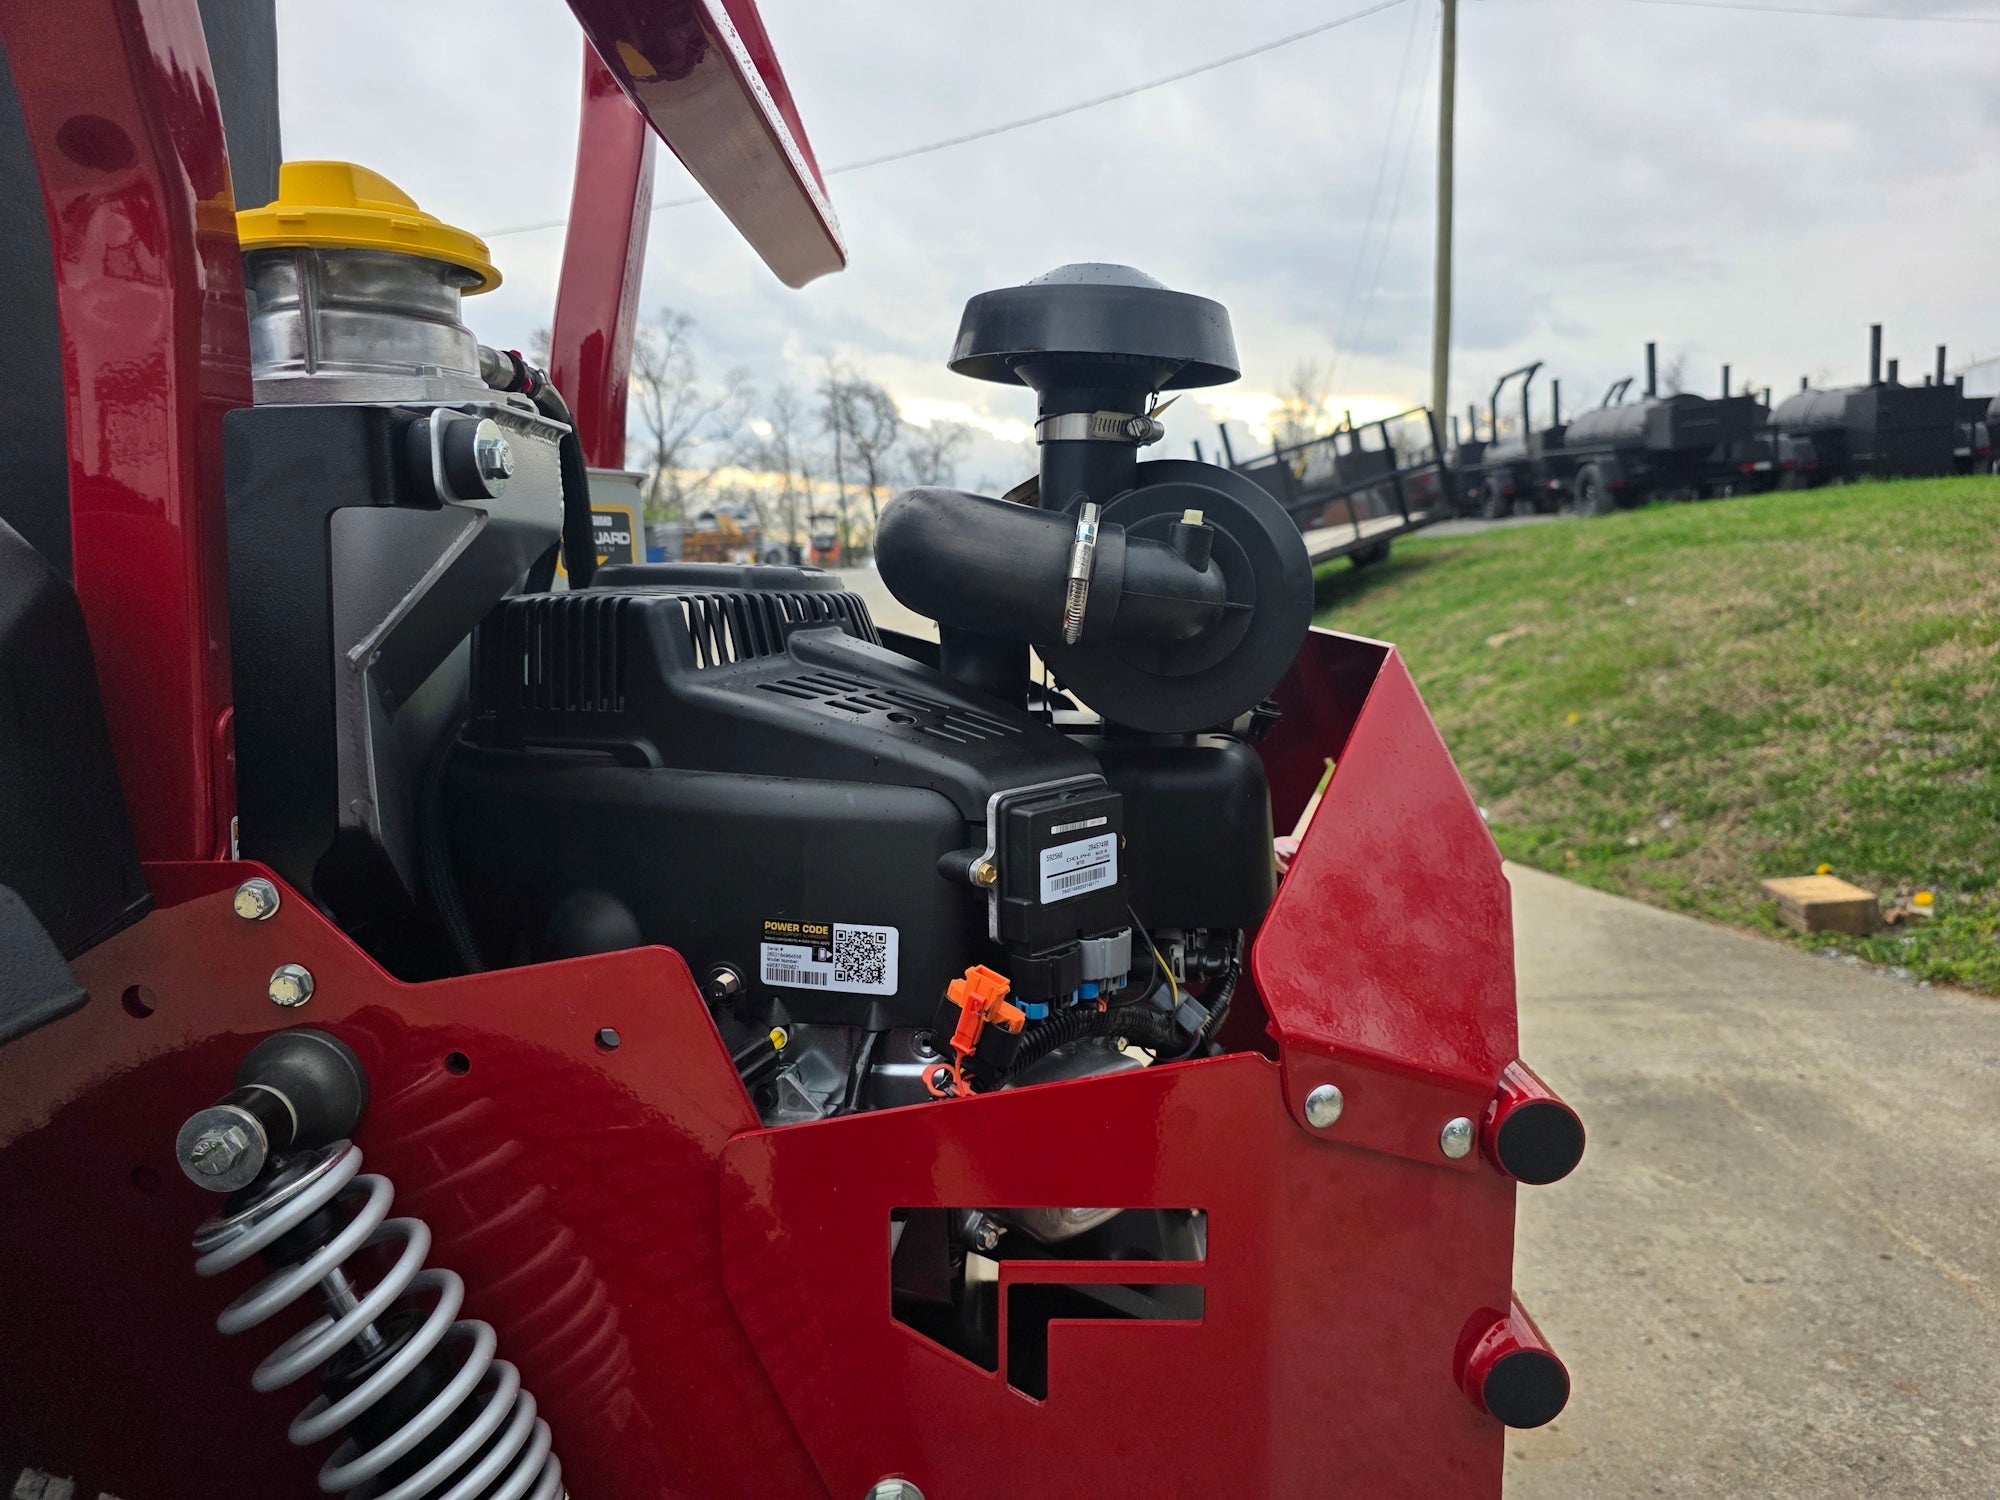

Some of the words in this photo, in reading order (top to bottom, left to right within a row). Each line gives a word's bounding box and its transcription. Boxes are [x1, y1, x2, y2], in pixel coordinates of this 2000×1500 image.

[593, 531, 631, 545] UARD
[1046, 851, 1063, 862] 592560
[764, 921, 800, 932] POWER
[802, 924, 829, 935] CODE
